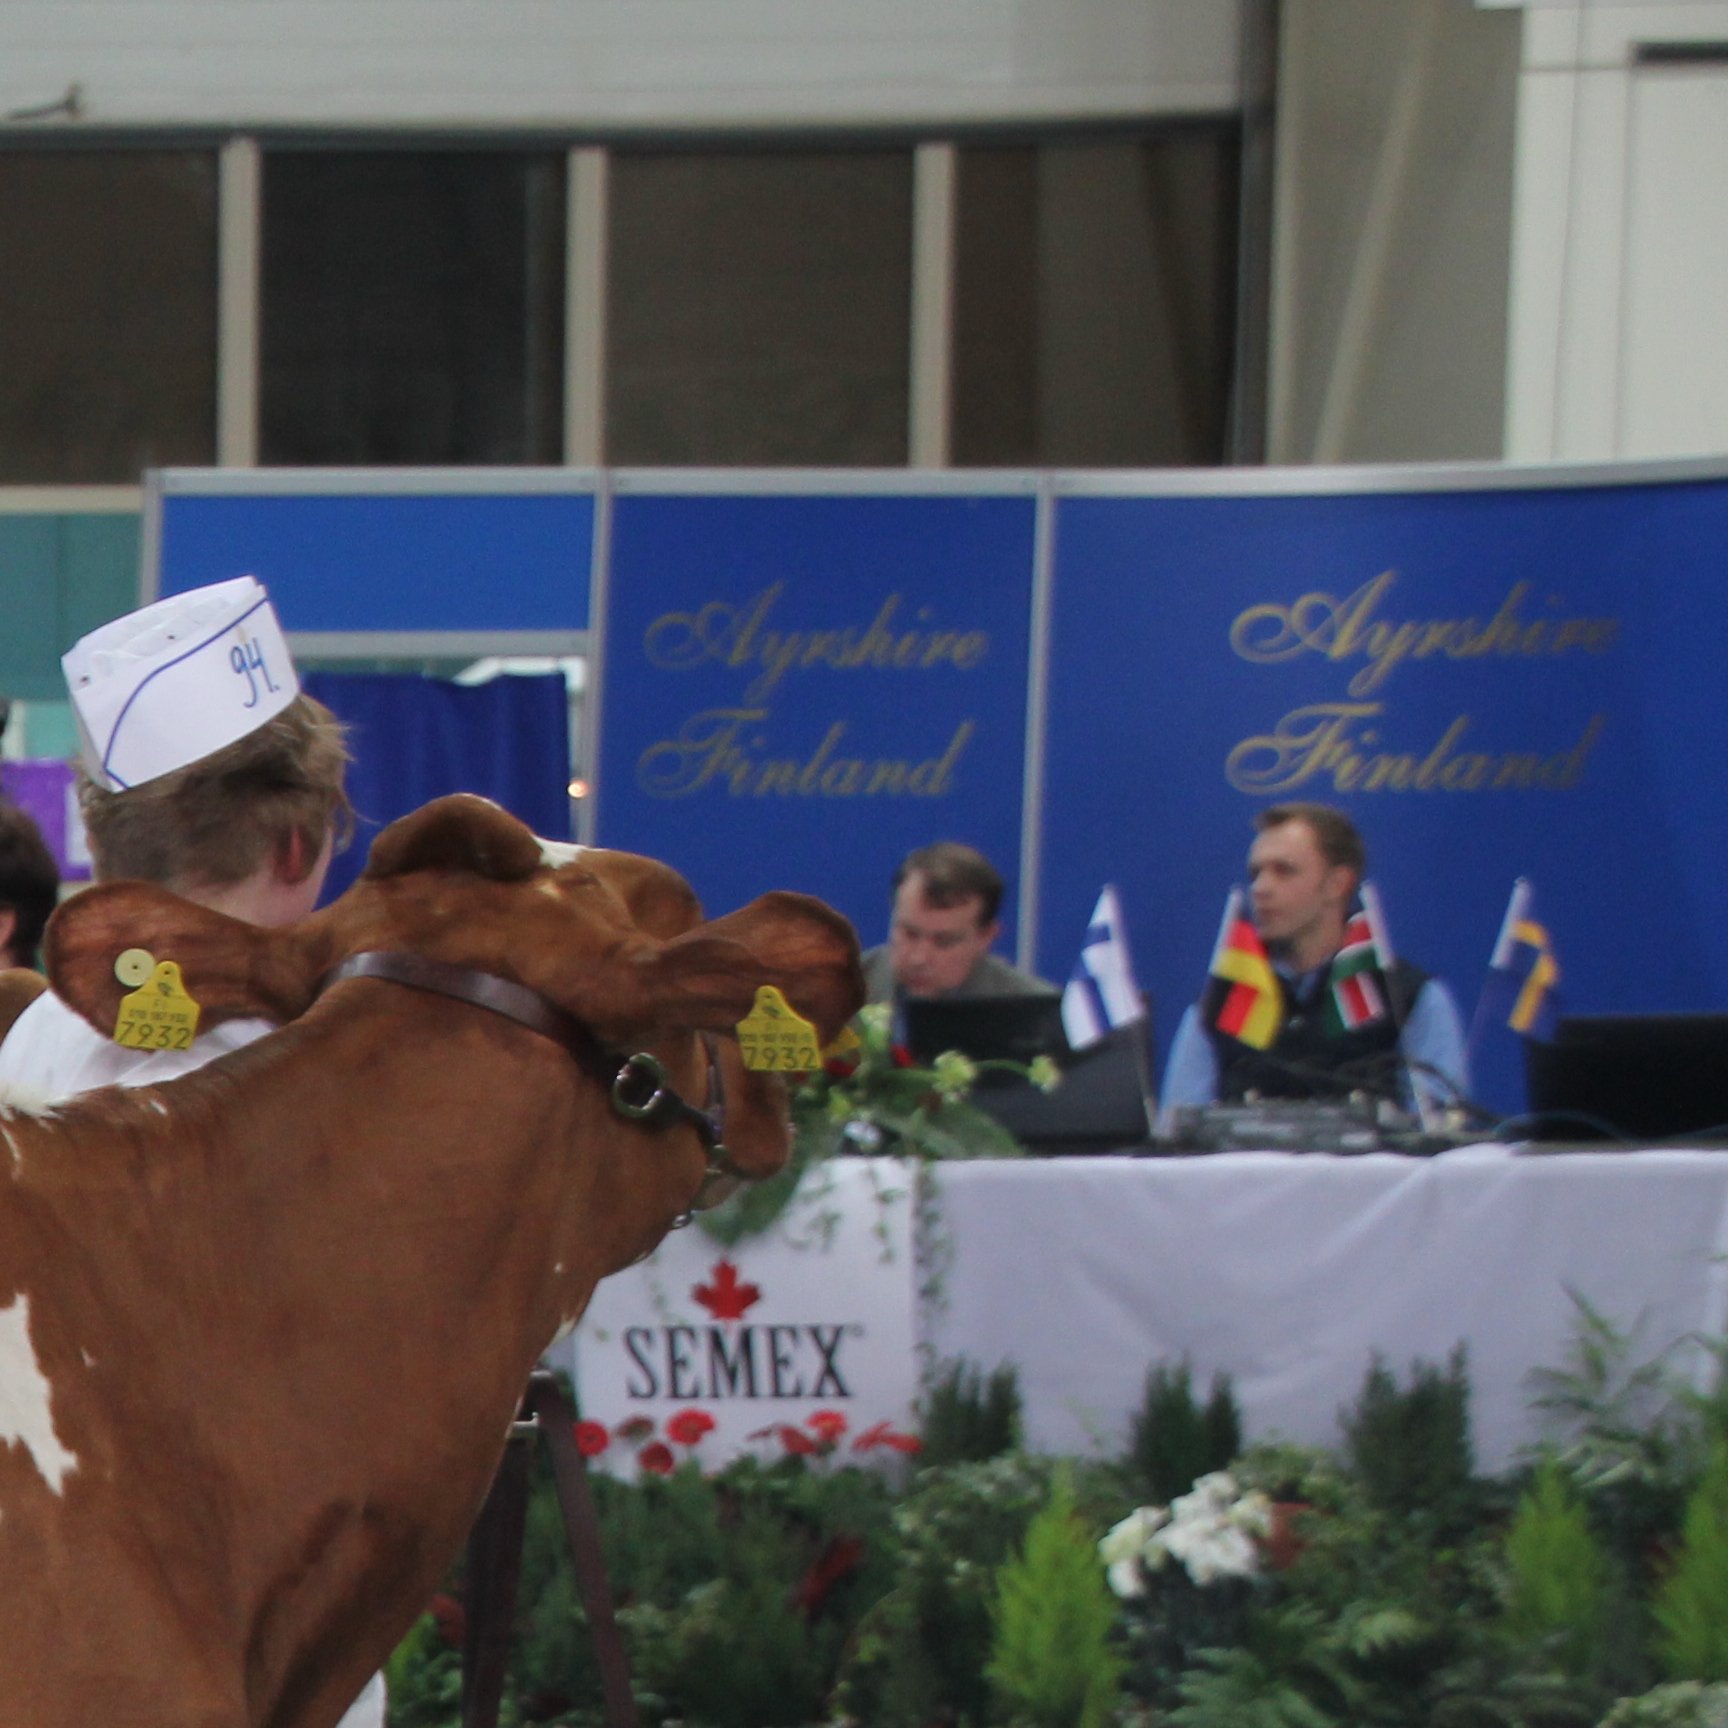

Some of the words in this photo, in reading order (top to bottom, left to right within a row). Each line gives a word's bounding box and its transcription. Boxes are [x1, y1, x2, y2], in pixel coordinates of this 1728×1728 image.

[645, 580, 990, 702] Ayrshire
[1229, 568, 1620, 698] Ayrshire
[639, 708, 976, 798] Finland
[1224, 702, 1607, 795] Finland
[117, 1020, 192, 1050] 7932
[742, 1045, 820, 1070] 7932
[623, 1322, 852, 1400] SEMEX
